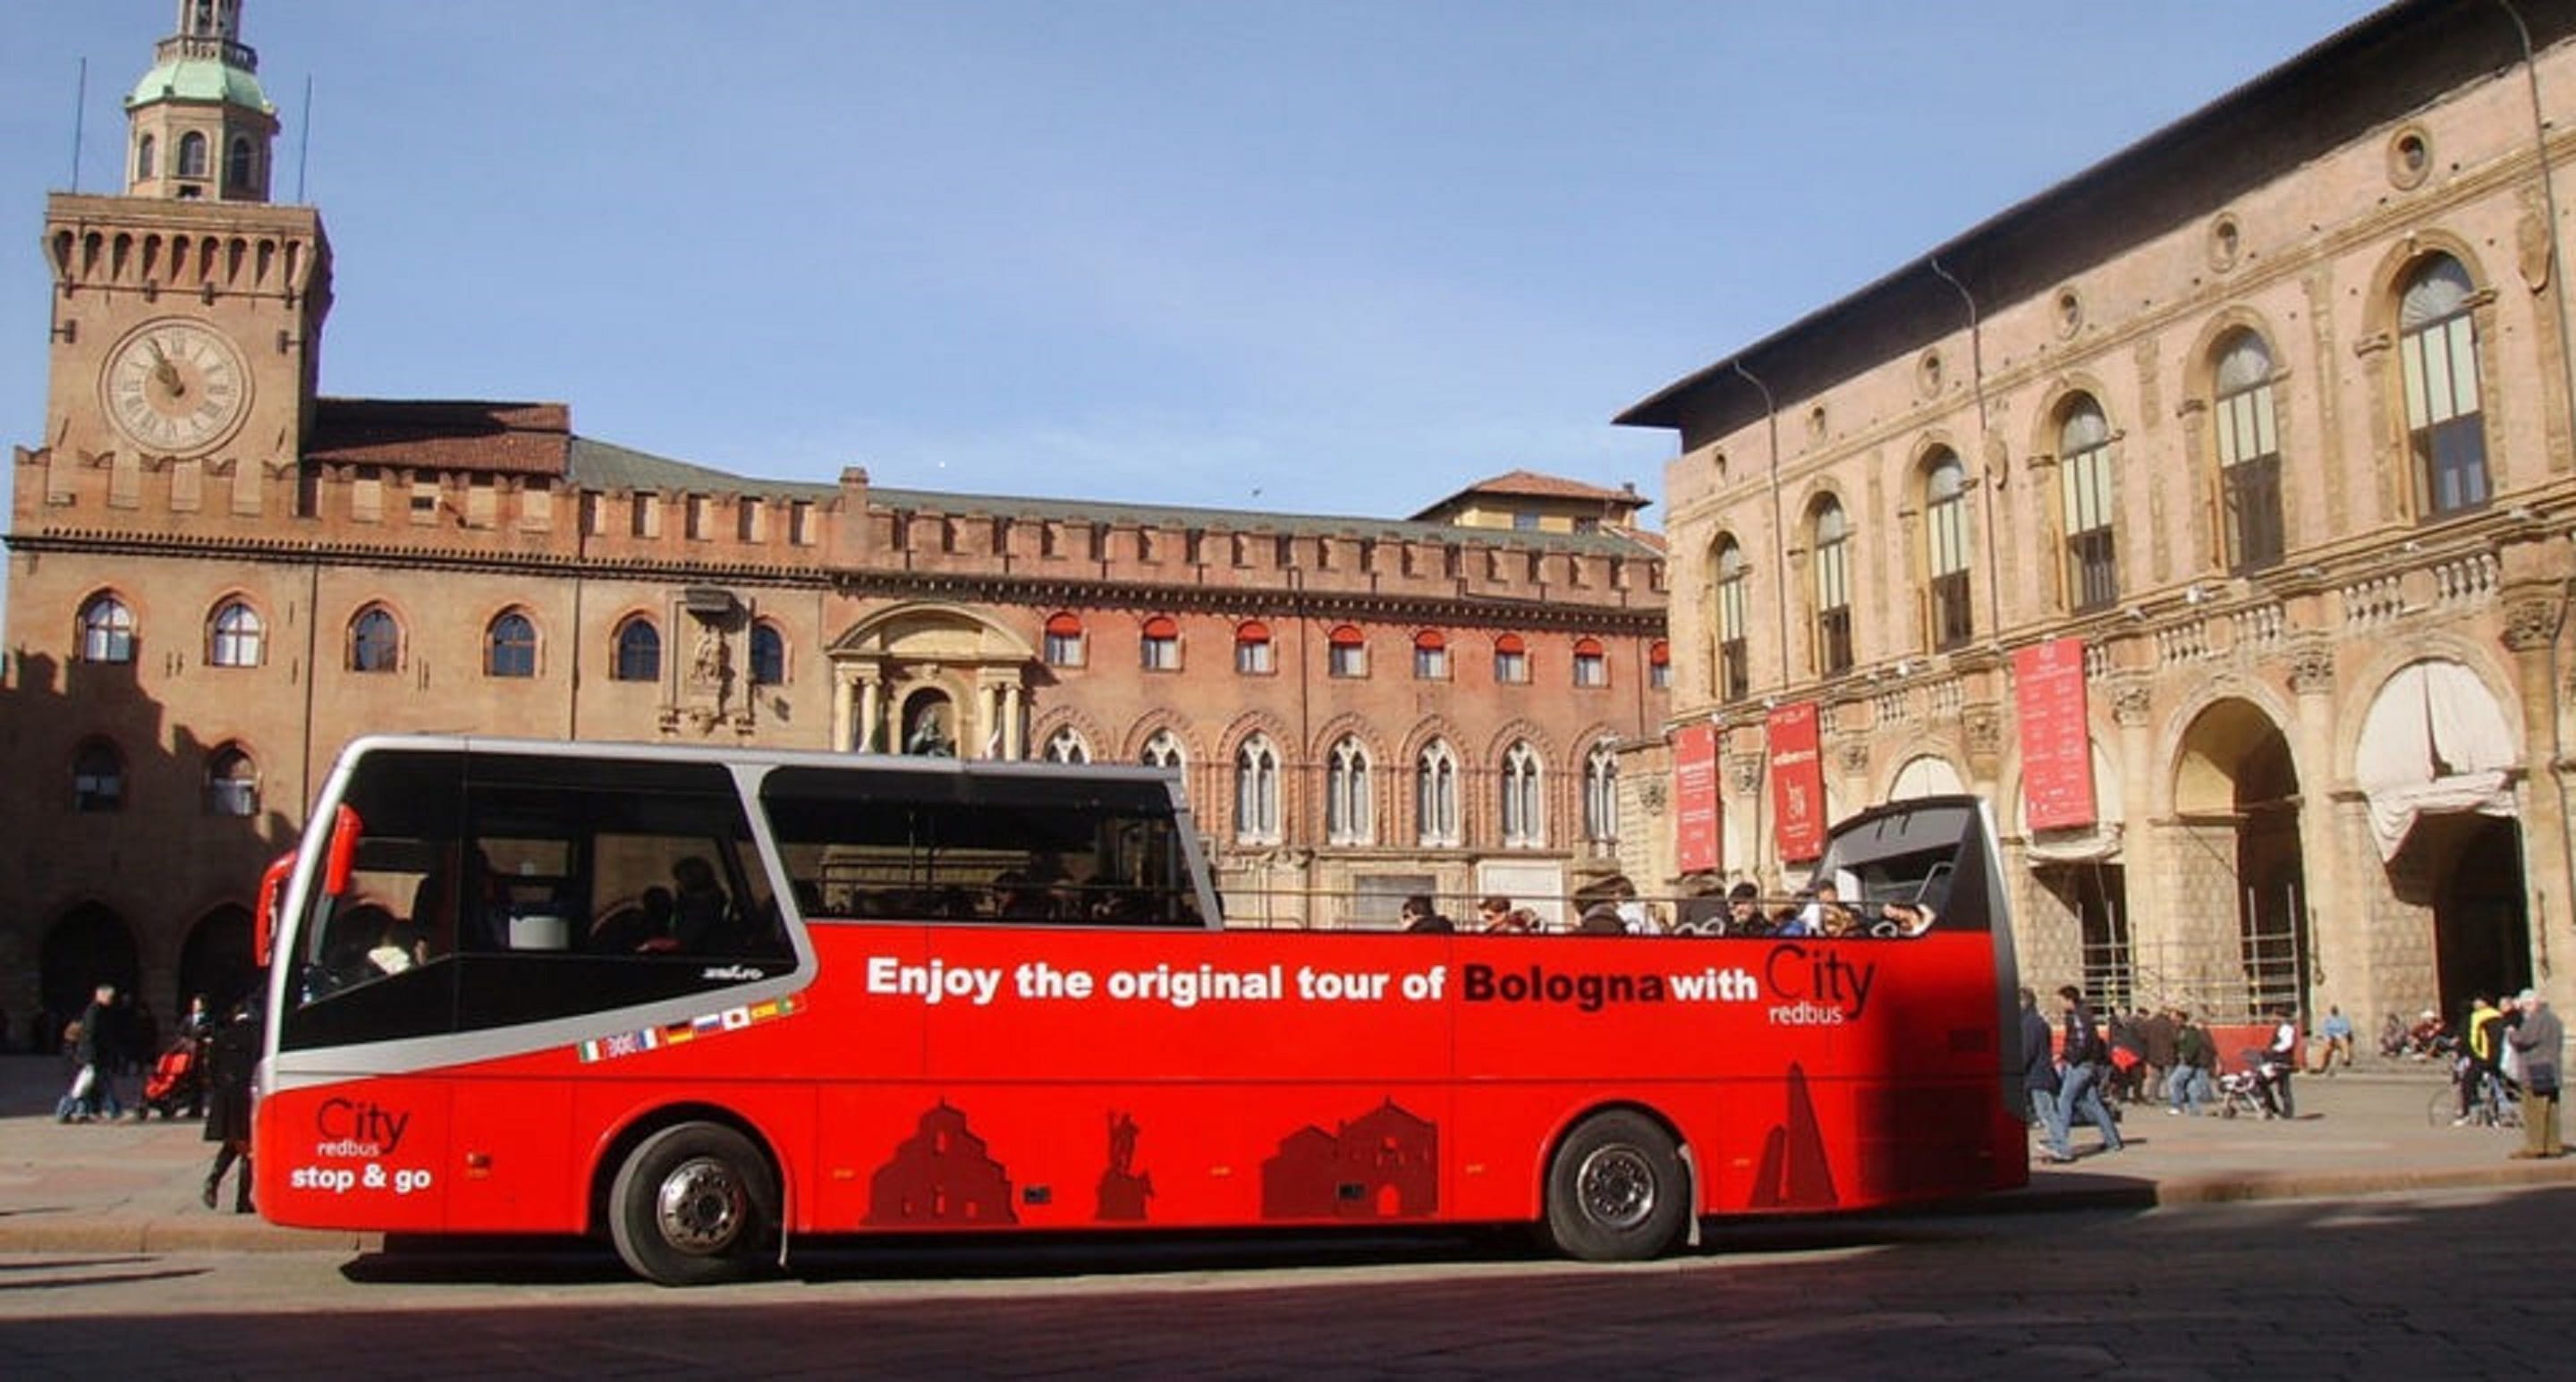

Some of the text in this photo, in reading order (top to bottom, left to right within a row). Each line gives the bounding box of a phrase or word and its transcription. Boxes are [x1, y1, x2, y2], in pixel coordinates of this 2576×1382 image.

[865, 955, 1758, 1013] Enjoy the original tour of Bologna with
[1766, 944, 1876, 1020] City
[1768, 1001, 1843, 1025] redbus
[316, 1138, 380, 1157] redbus
[317, 1097, 411, 1156] City
[290, 1162, 432, 1194] stop & go
